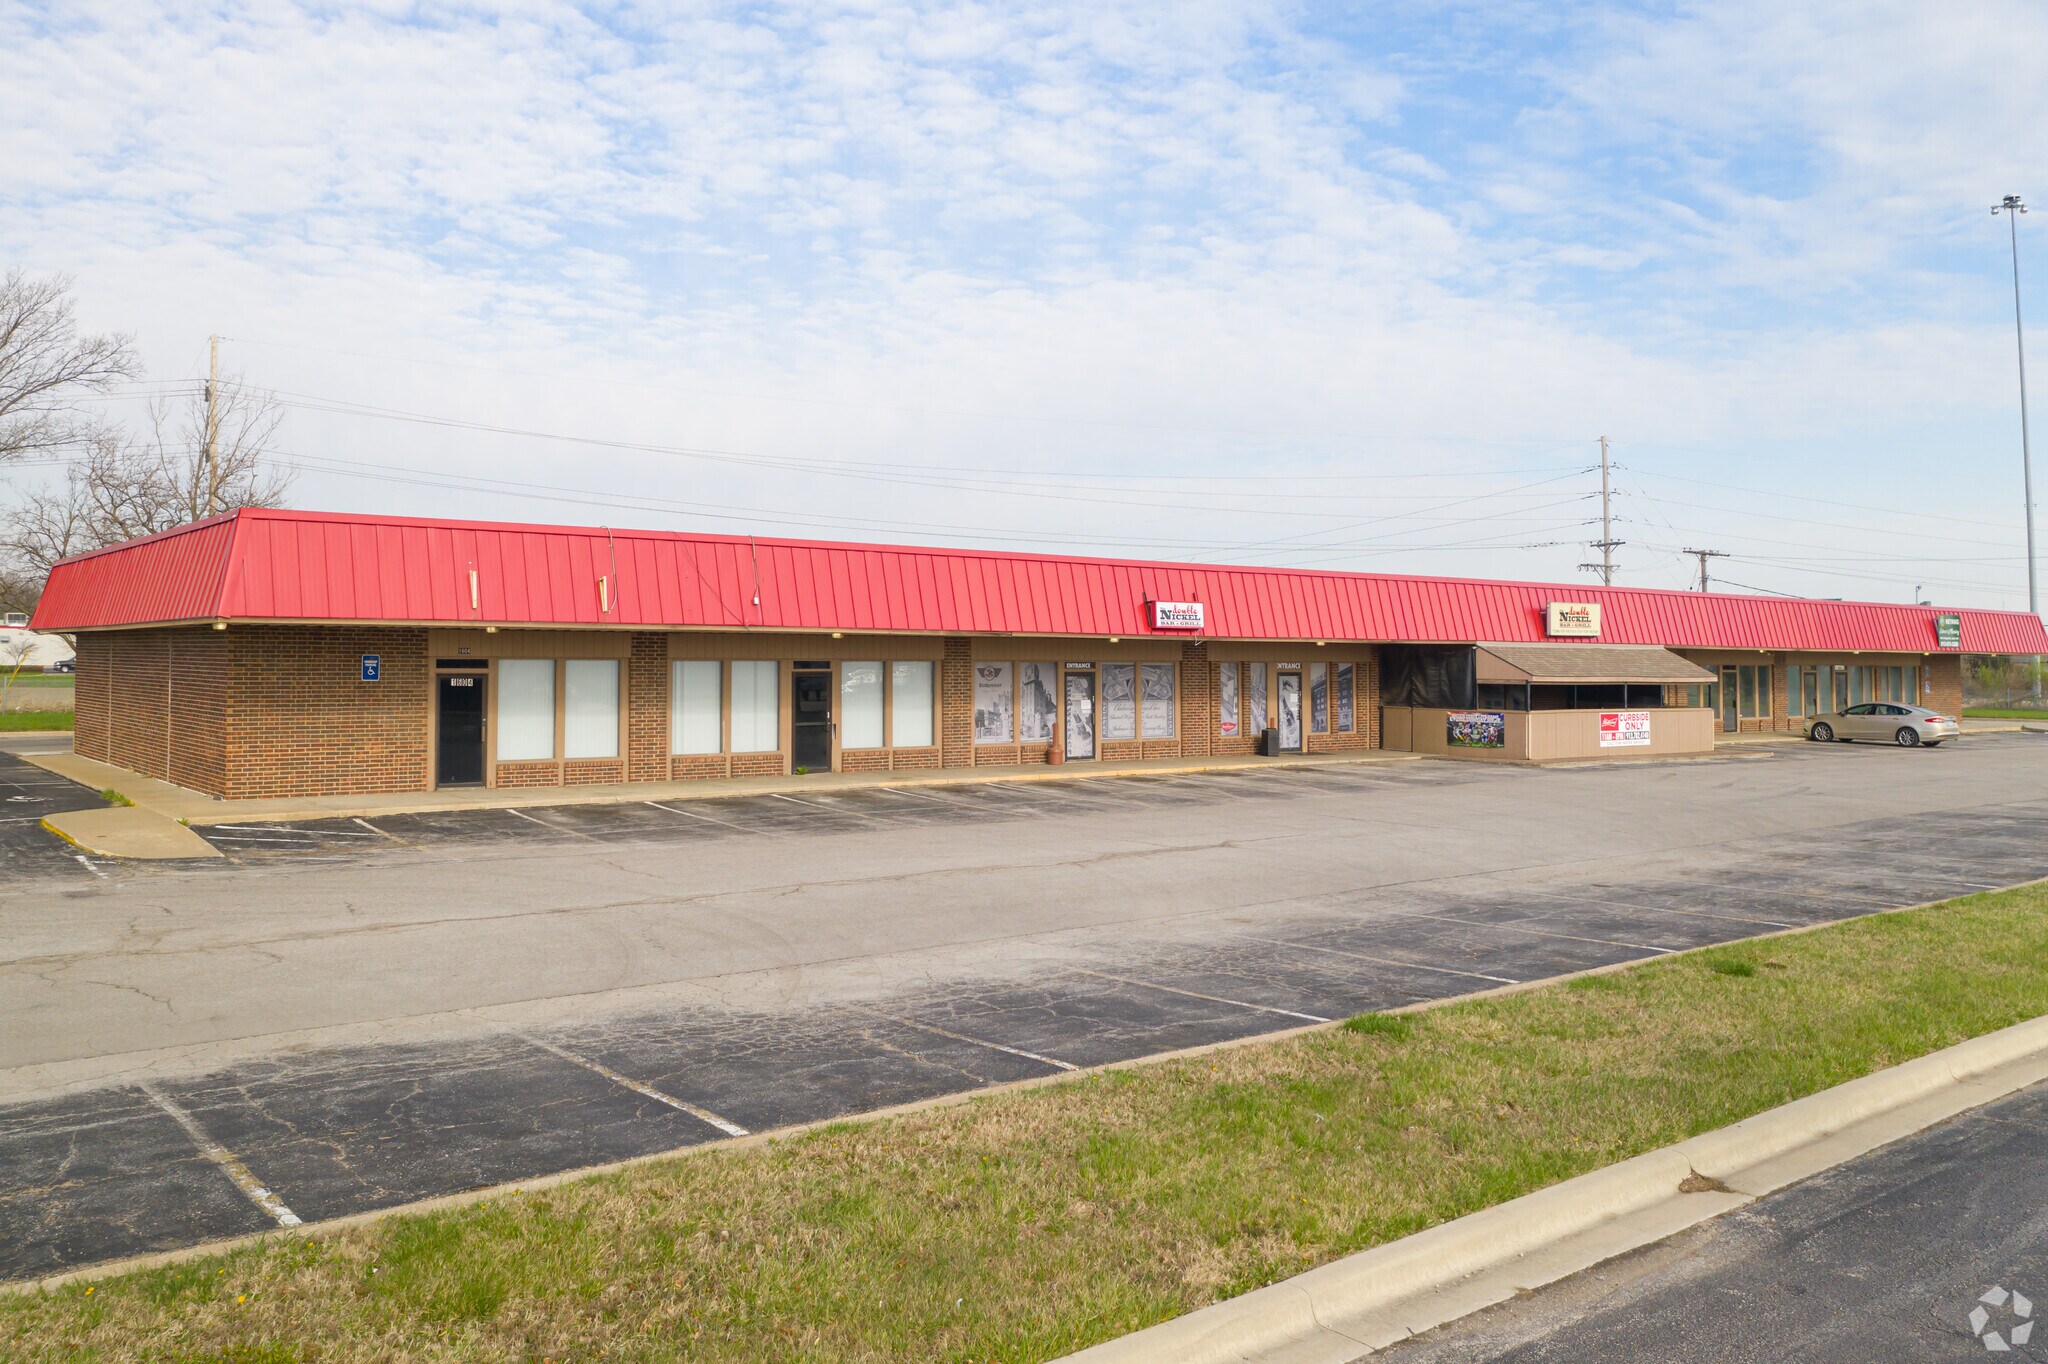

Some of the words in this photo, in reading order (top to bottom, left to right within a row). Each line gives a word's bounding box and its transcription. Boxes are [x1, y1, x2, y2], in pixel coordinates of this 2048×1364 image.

[1173, 604, 1198, 614] double
[1569, 606, 1589, 615] double
[1160, 610, 1201, 620] NICKEL
[1559, 612, 1591, 622] NICKEL
[1620, 713, 1649, 721] CURBSIDE
[1625, 722, 1644, 730] ONLY
